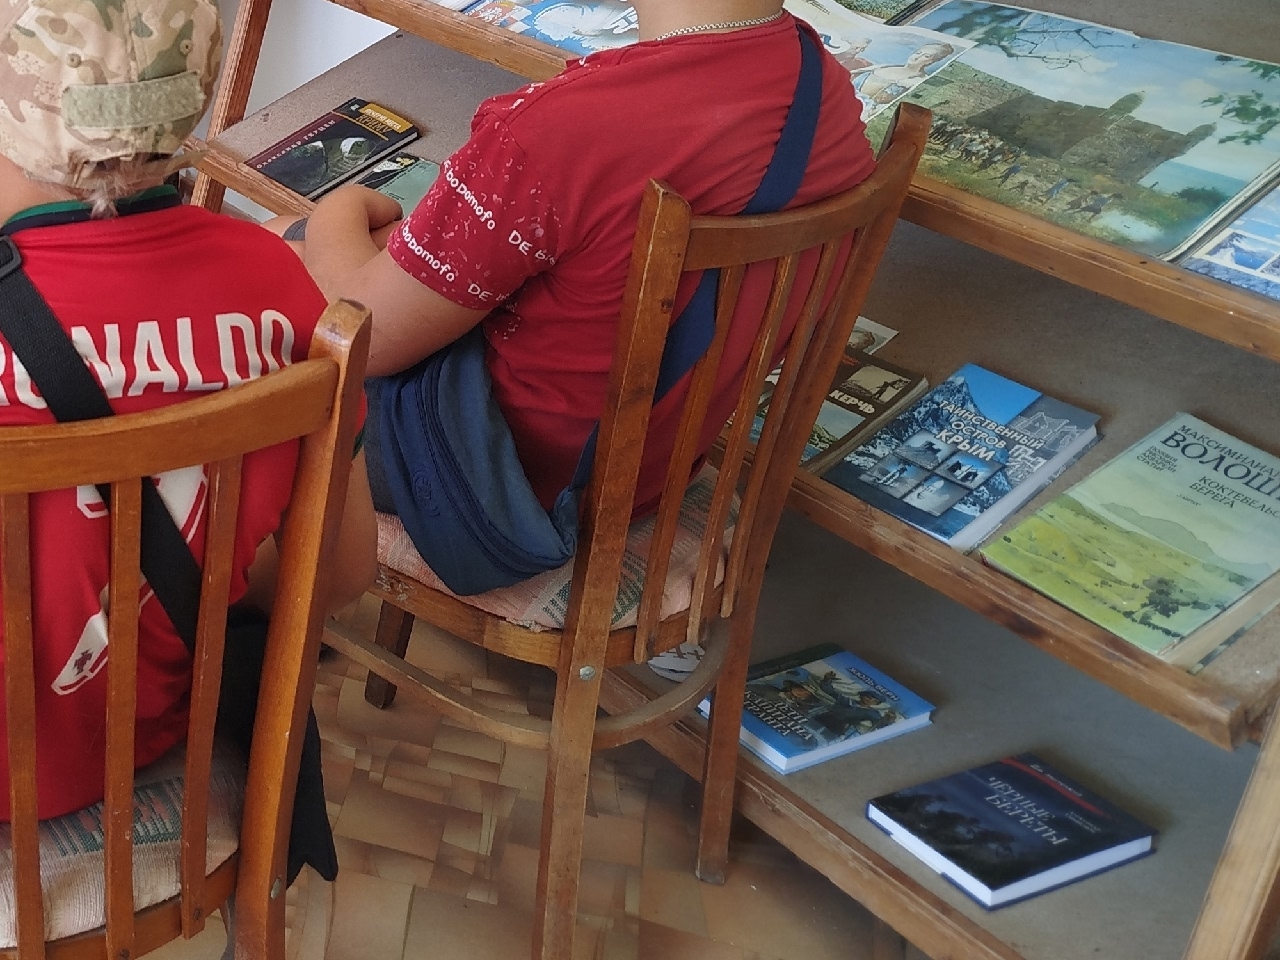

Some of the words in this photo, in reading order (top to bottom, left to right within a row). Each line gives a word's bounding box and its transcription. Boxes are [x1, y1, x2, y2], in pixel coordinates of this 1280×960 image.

[828, 389, 875, 414] КЕРЧЬ
[939, 400, 1046, 450] ТАИНСТВЕННЫЙ
[951, 421, 1007, 449] ОСТРОВ
[936, 428, 996, 462] КРЫМ
[1160, 430, 1280, 502] ВОЛОШ
[1189, 482, 1235, 508] БЕРЕГА
[875, 684, 899, 701] ВЕРН
[744, 690, 814, 740] КАПИТАНА
[773, 700, 809, 724] ДЕТИ
[989, 777, 1055, 821] ЧЕРНЫЕ
[985, 795, 1068, 845] БЕРЕТЫ
